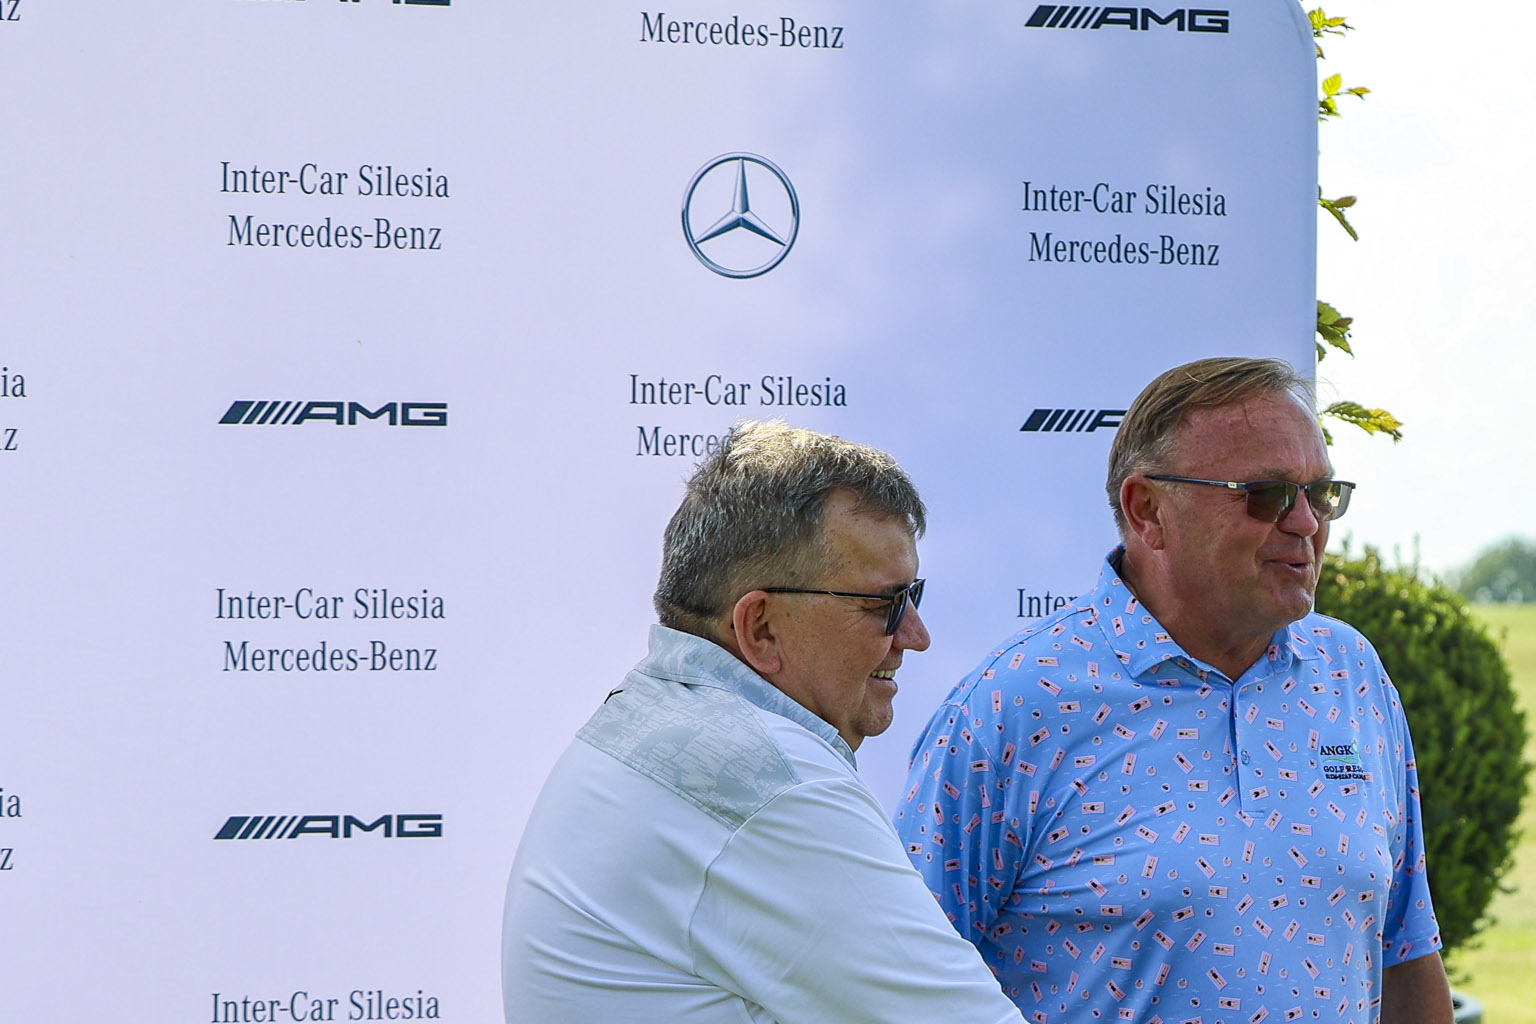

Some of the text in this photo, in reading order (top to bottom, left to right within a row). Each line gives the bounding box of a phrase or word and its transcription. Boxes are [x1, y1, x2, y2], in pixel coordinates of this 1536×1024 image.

[639, 11, 844, 49] Mercedes-Benz
[1098, 6, 1230, 34] AMG
[220, 161, 450, 198] Inter-Car Silesia
[1022, 181, 1227, 217] Inter-Car Silesia
[227, 214, 442, 250] Mercedes-Benz
[1028, 231, 1220, 266] Mercedes-Benz
[629, 373, 848, 407] Inter-Car Silesia
[299, 401, 448, 427] AMG
[215, 587, 446, 620] Inter-Car Silesia
[222, 640, 437, 672] Mercedes-Benz
[291, 813, 443, 839] AMG
[211, 989, 440, 1024] Inter-Car Silesia
